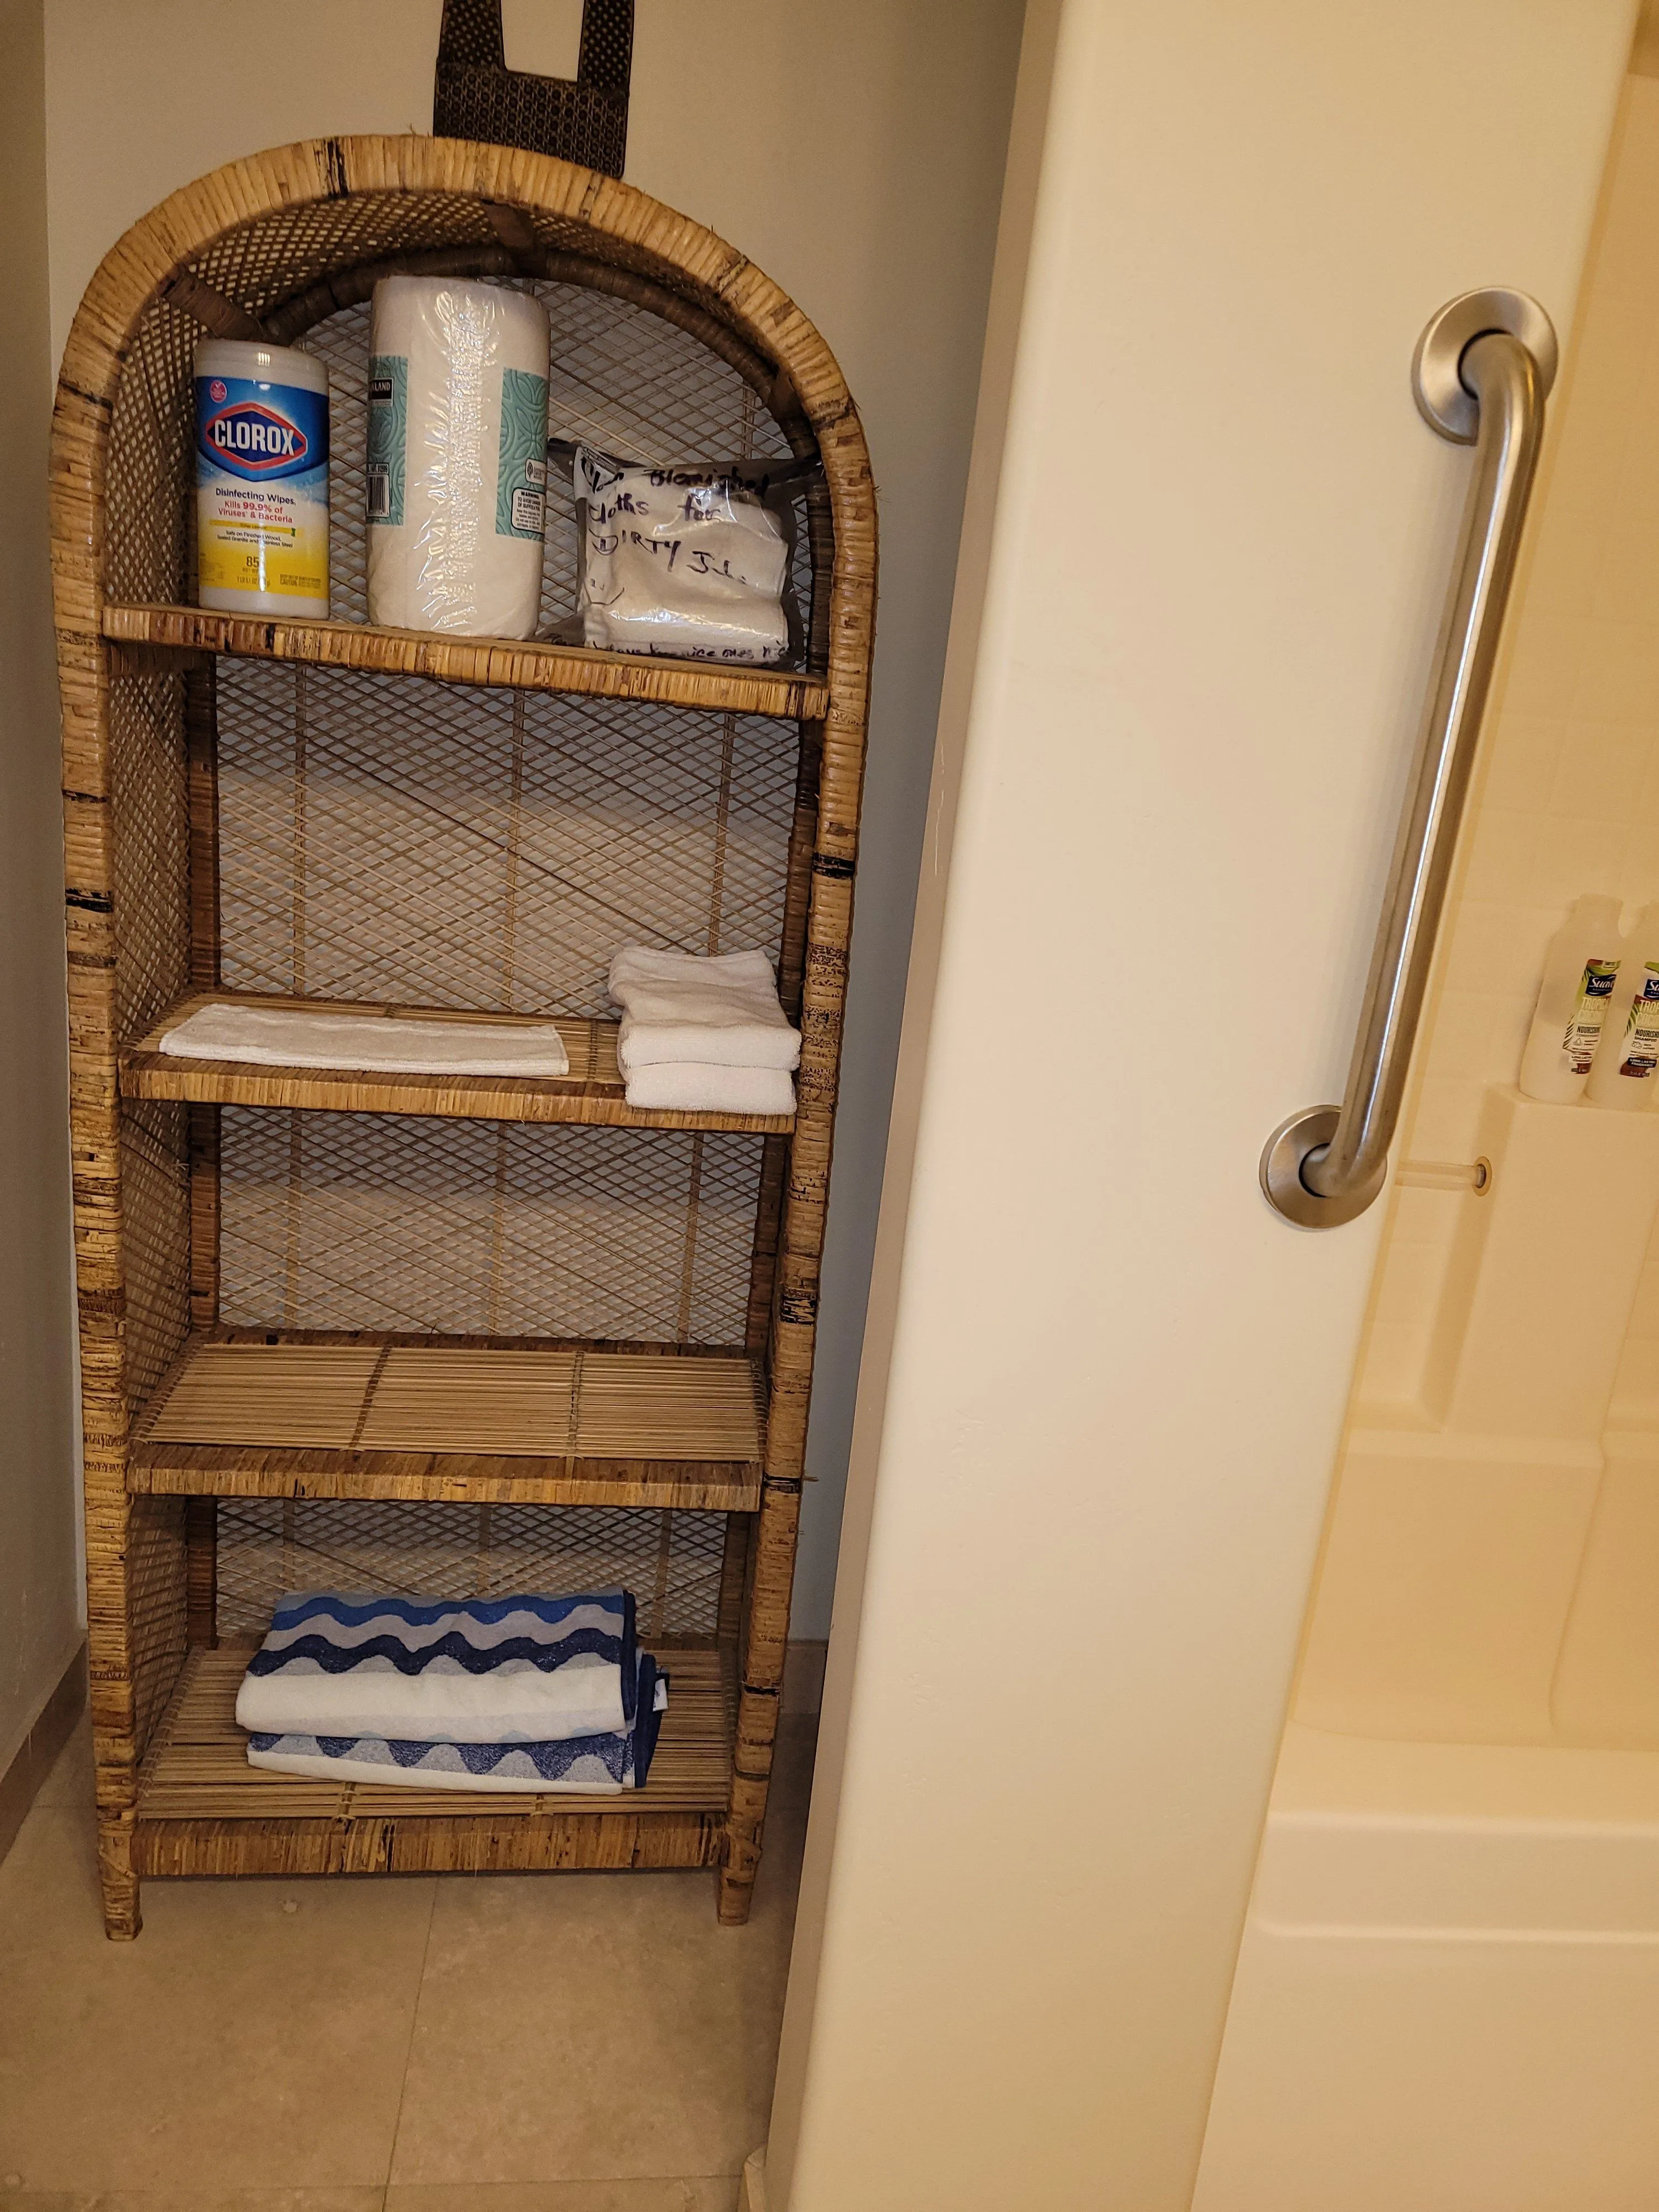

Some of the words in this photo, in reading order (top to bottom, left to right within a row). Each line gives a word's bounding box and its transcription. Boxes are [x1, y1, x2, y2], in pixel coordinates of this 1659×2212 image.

[215, 419, 295, 456] CLOROX
[216, 488, 264, 501] Disinfecting
[225, 500, 241, 509] Kills
[243, 501, 272, 512] 99.9%
[258, 512, 293, 523] Bacteria
[589, 528, 682, 572] DIRTY
[246, 556, 259, 568] 85
